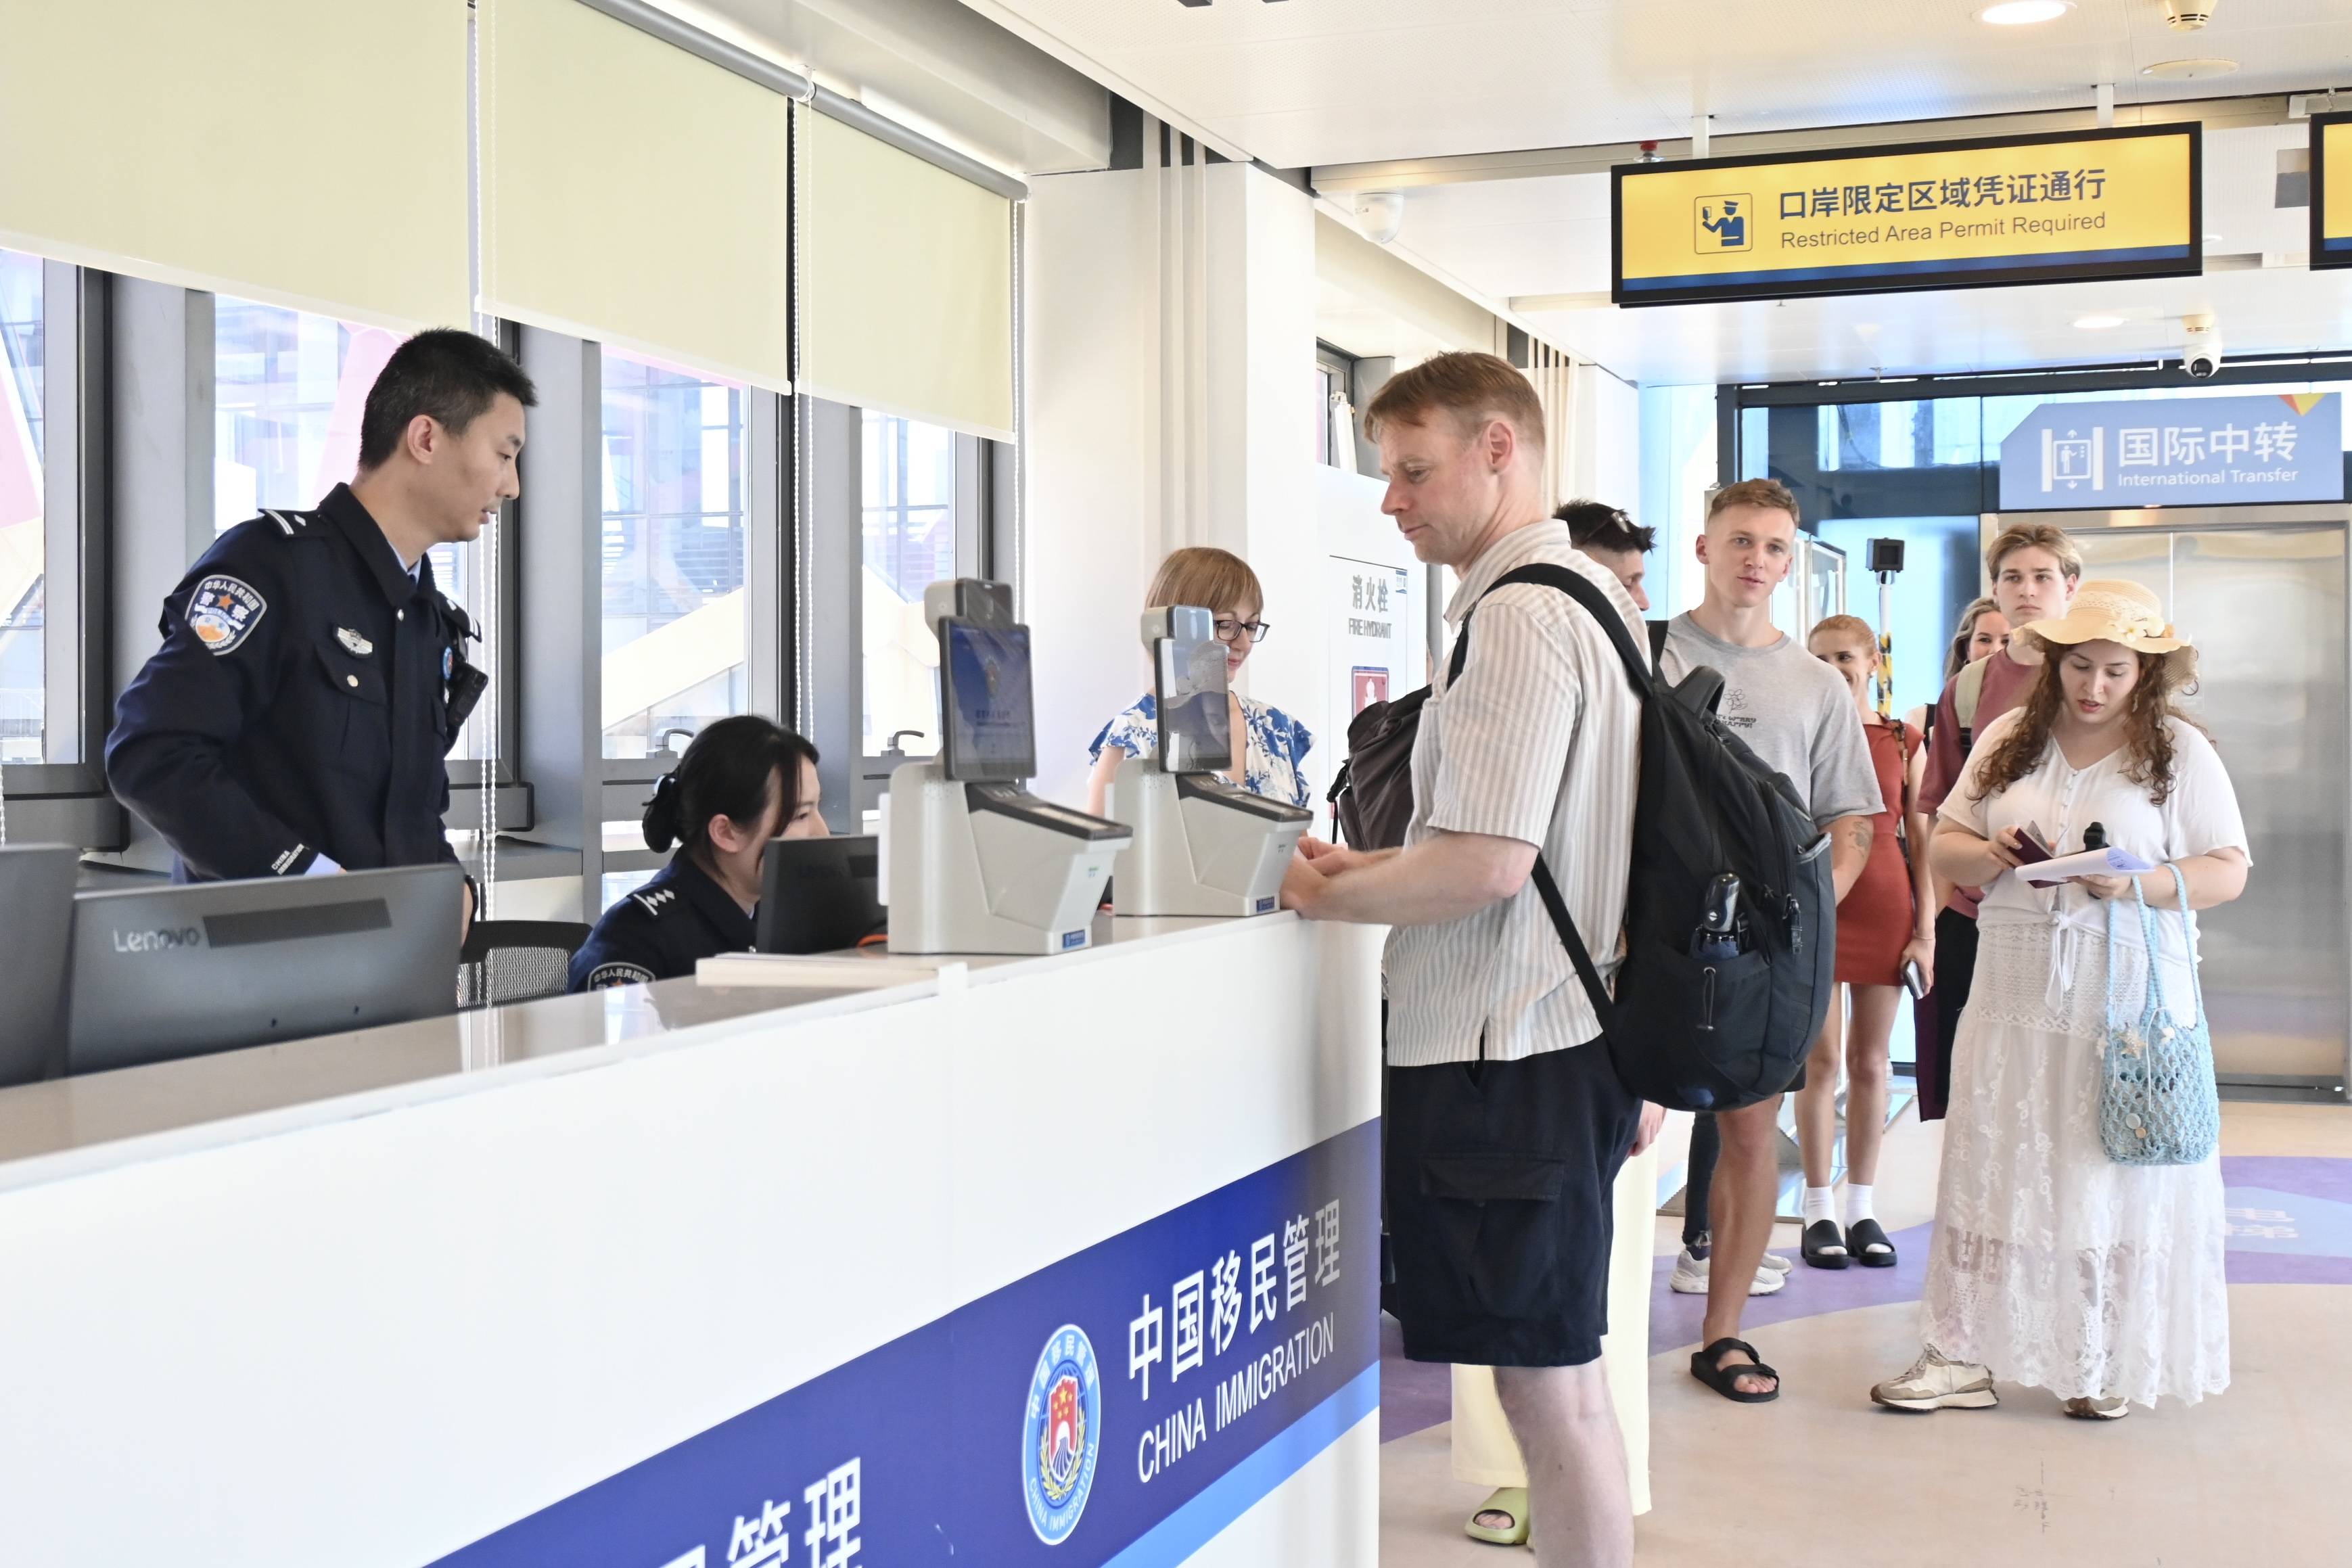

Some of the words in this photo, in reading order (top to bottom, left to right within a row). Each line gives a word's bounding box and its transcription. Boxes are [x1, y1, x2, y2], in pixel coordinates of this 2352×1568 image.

[1779, 168, 2106, 220] 口岸限定区域凭证通行
[1781, 227, 1879, 248] Restricted
[1885, 223, 1932, 242] Area
[1940, 218, 2006, 237] Permit
[2013, 212, 2106, 237] Required
[2119, 421, 2298, 467] 国际中转
[2119, 471, 2225, 486] International
[2232, 468, 2298, 482] Transfer
[1353, 575, 1388, 613] 消火栓
[1348, 618, 1363, 636] FIRE
[271, 850, 291, 871] CHINA
[112, 926, 200, 952] Lenovo
[1128, 1198, 1340, 1402] 中国移民管理
[1138, 1397, 1207, 1483] CHINA
[1216, 1312, 1334, 1432] IMMIGRATION
[1030, 1477, 1048, 1527] CHINA
[1049, 1442, 1094, 1532] IMMIGRATION
